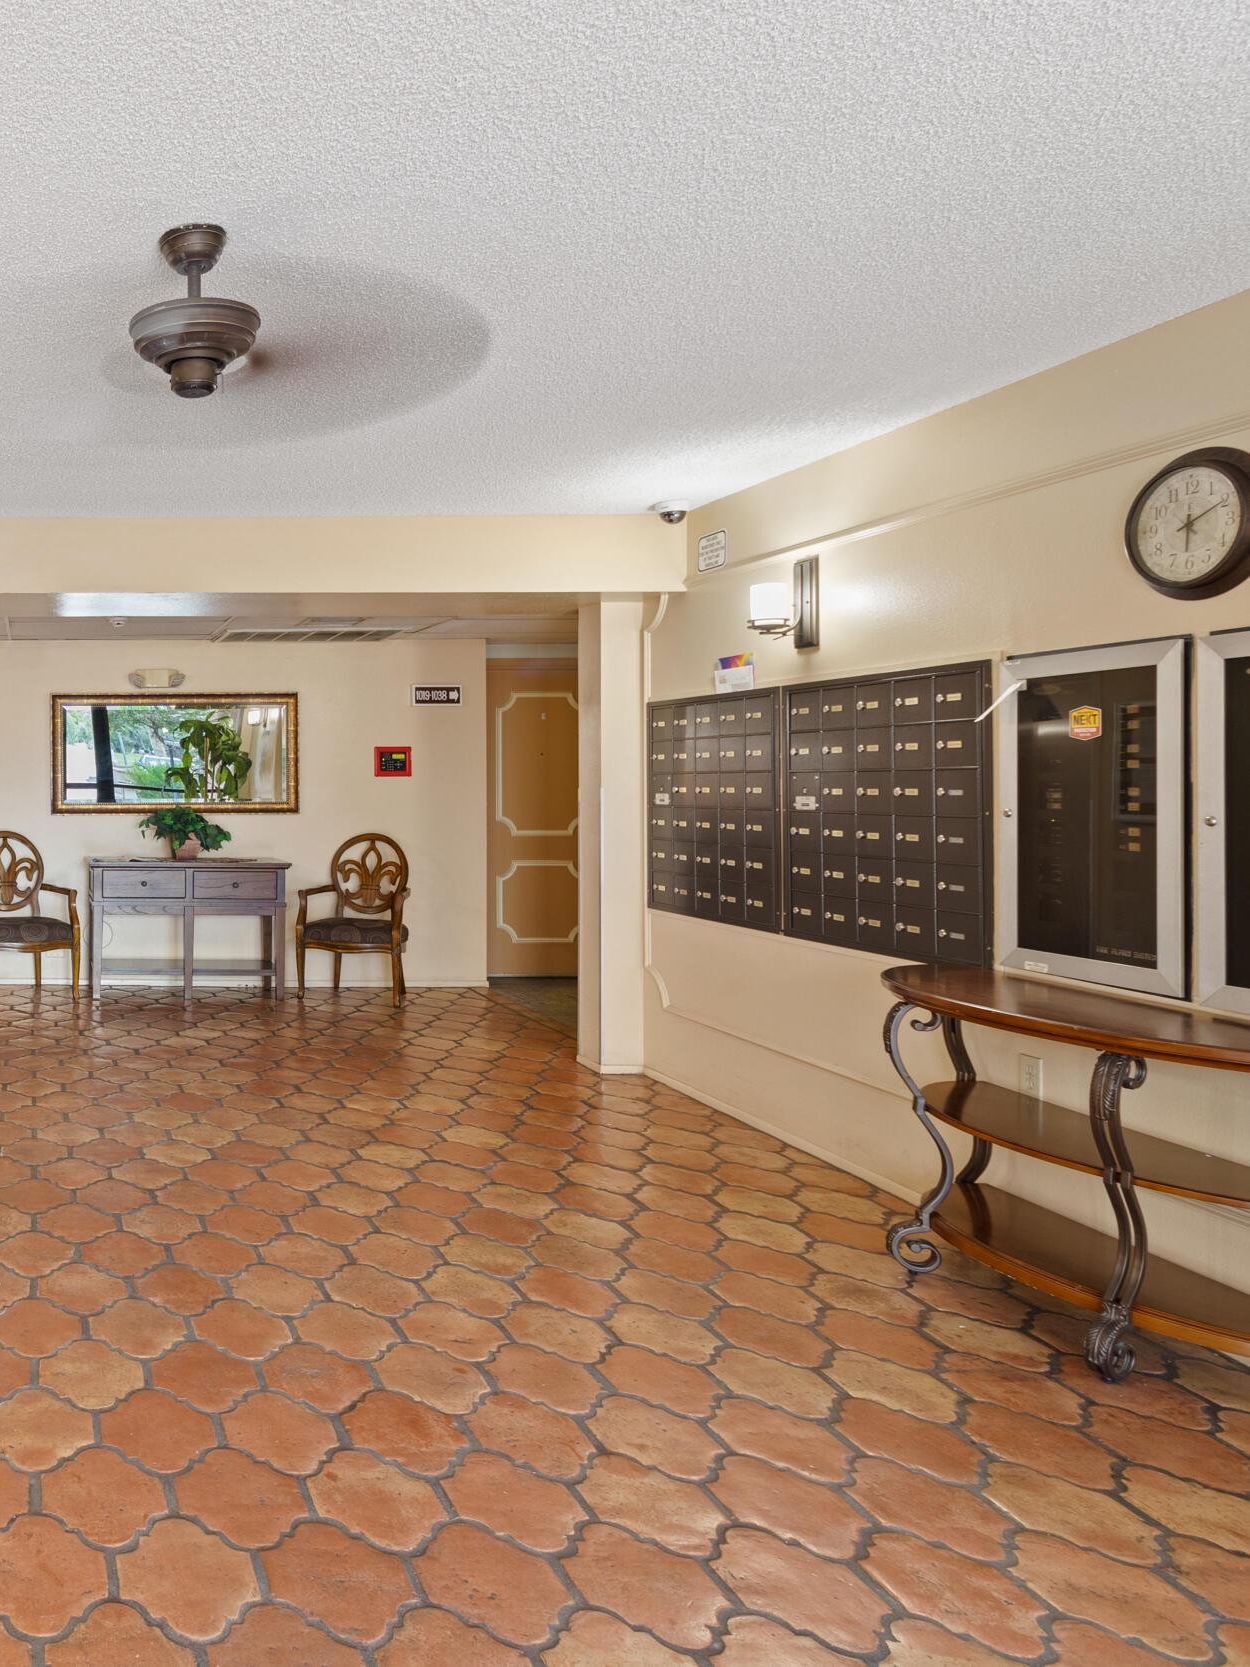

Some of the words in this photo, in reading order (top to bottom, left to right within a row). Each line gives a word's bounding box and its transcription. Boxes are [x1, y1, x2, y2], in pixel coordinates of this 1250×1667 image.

[1185, 480, 1199, 495] 12
[1209, 481, 1213, 495] 1
[1168, 488, 1179, 503] 11
[1221, 492, 1229, 508] 2
[1153, 504, 1167, 520] 10
[1225, 511, 1235, 526] 3
[1150, 524, 1157, 539] 9
[1154, 542, 1162, 556] 8
[1170, 553, 1178, 568] 7
[1185, 555, 1194, 570] 6
[416, 690, 447, 701] 1019-1038
